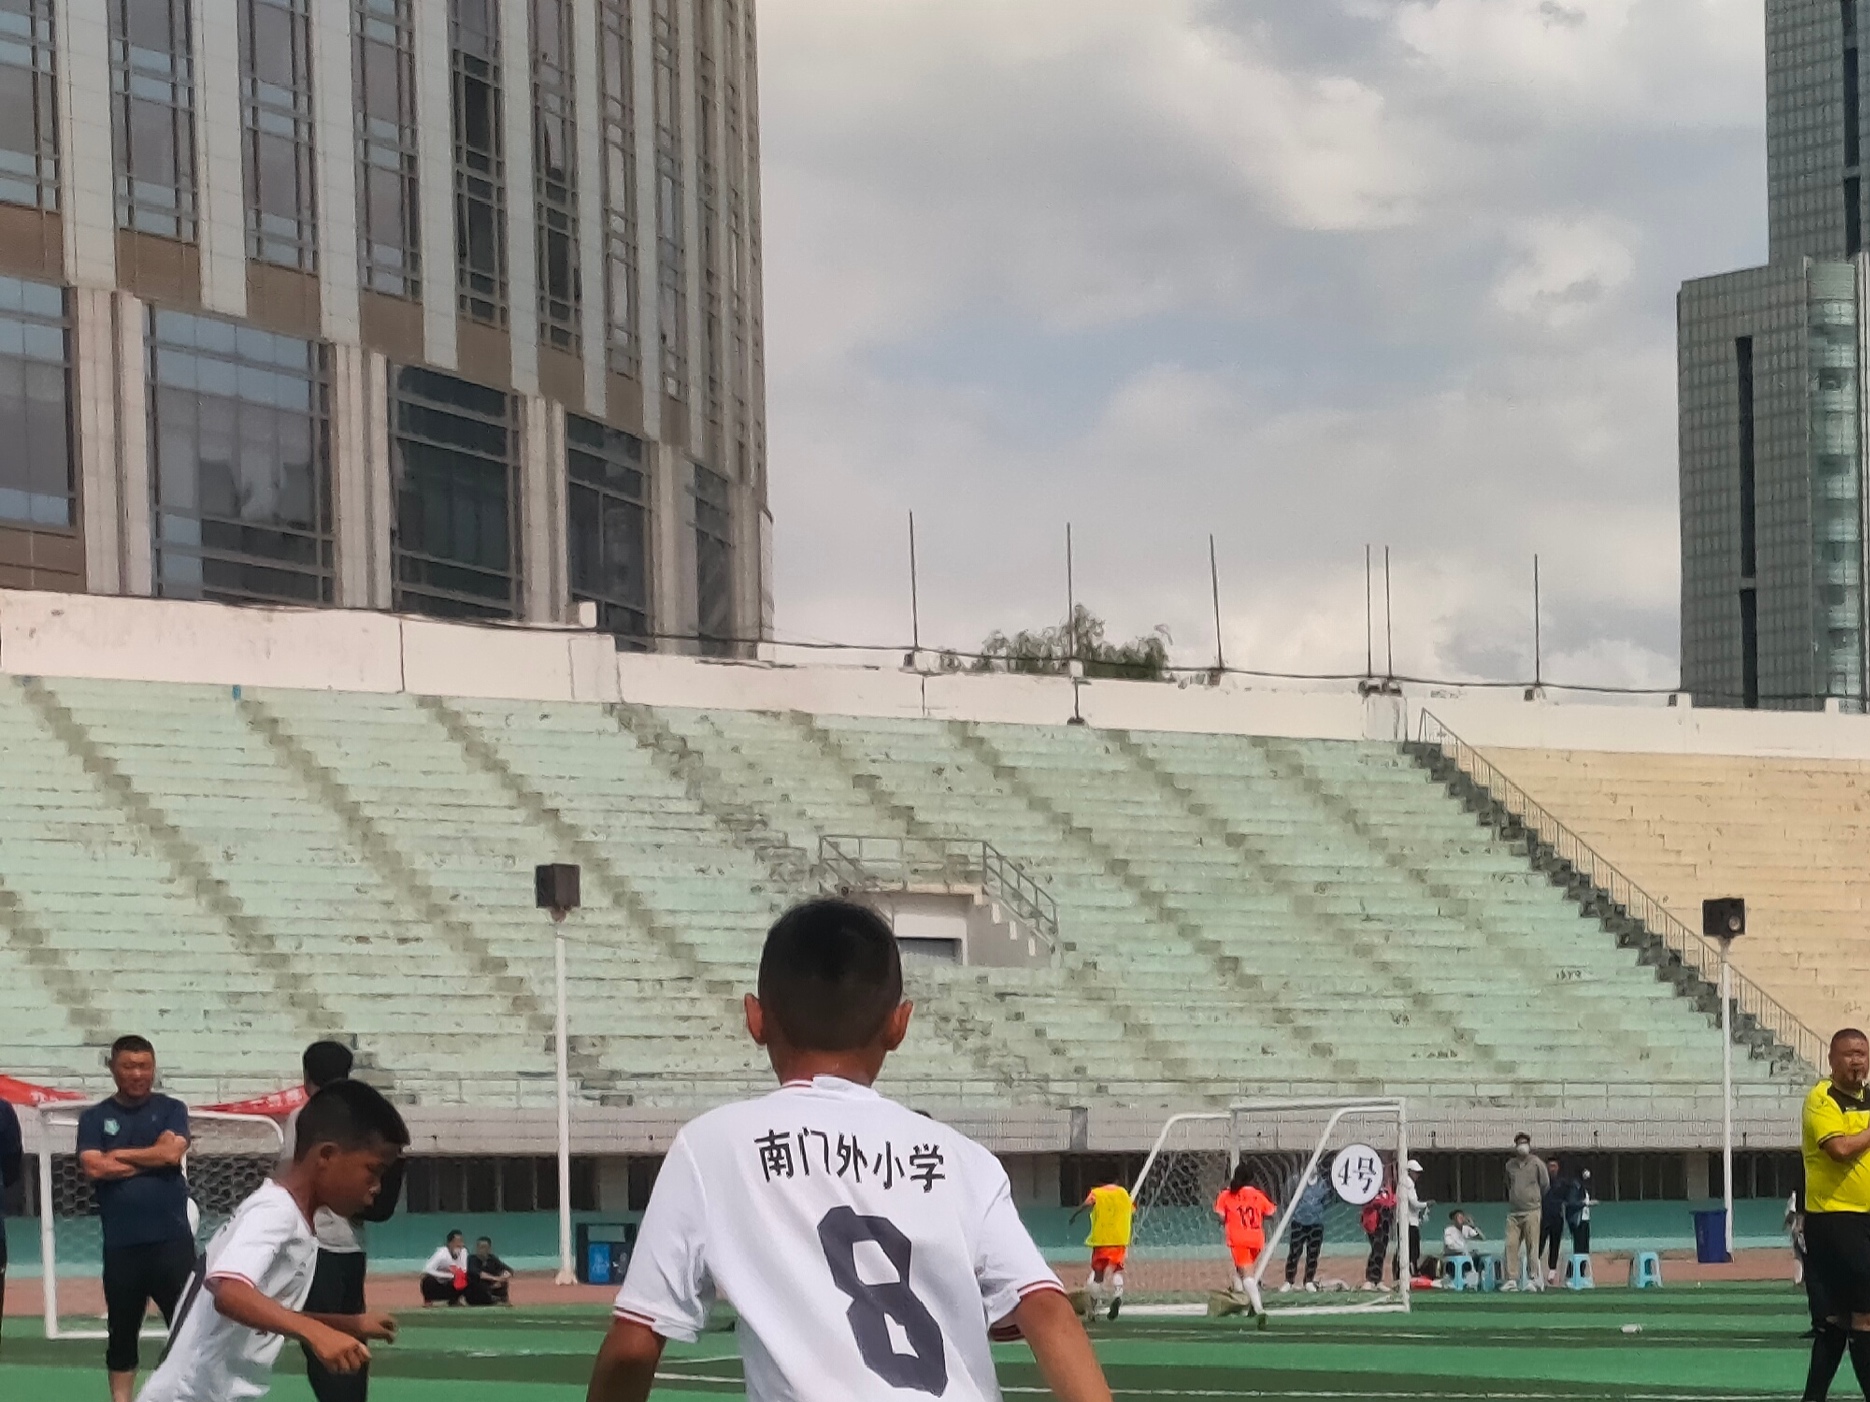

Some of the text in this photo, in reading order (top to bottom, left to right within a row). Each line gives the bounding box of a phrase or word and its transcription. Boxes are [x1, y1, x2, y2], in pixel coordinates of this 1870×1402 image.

[753, 1126, 946, 1194] 南门外小学
[1338, 1156, 1377, 1194] 4号
[816, 1205, 949, 1399] 8
